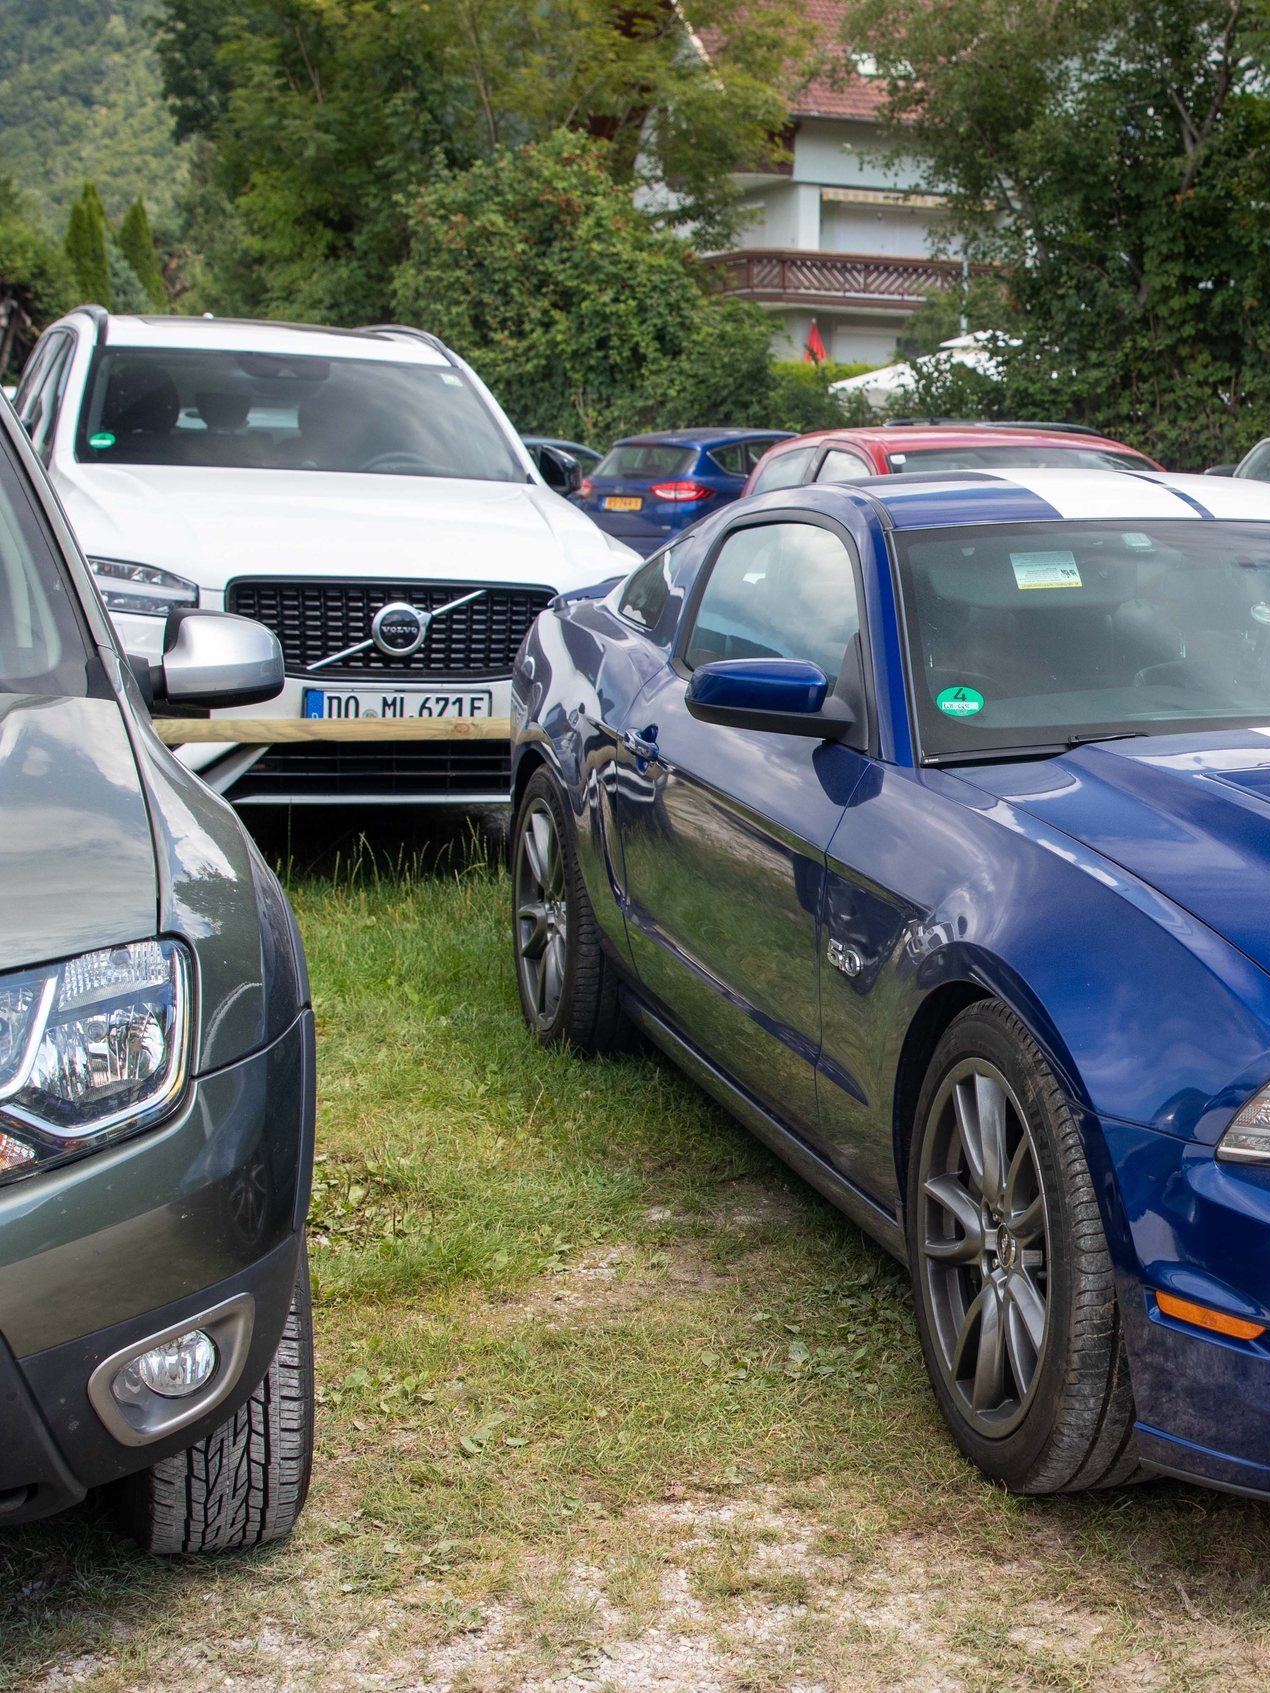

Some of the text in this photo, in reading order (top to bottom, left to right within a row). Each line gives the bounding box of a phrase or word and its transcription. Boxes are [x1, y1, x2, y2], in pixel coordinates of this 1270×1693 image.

[381, 625, 418, 633] VOLVO
[953, 687, 967, 702] 4
[327, 695, 360, 719] DO
